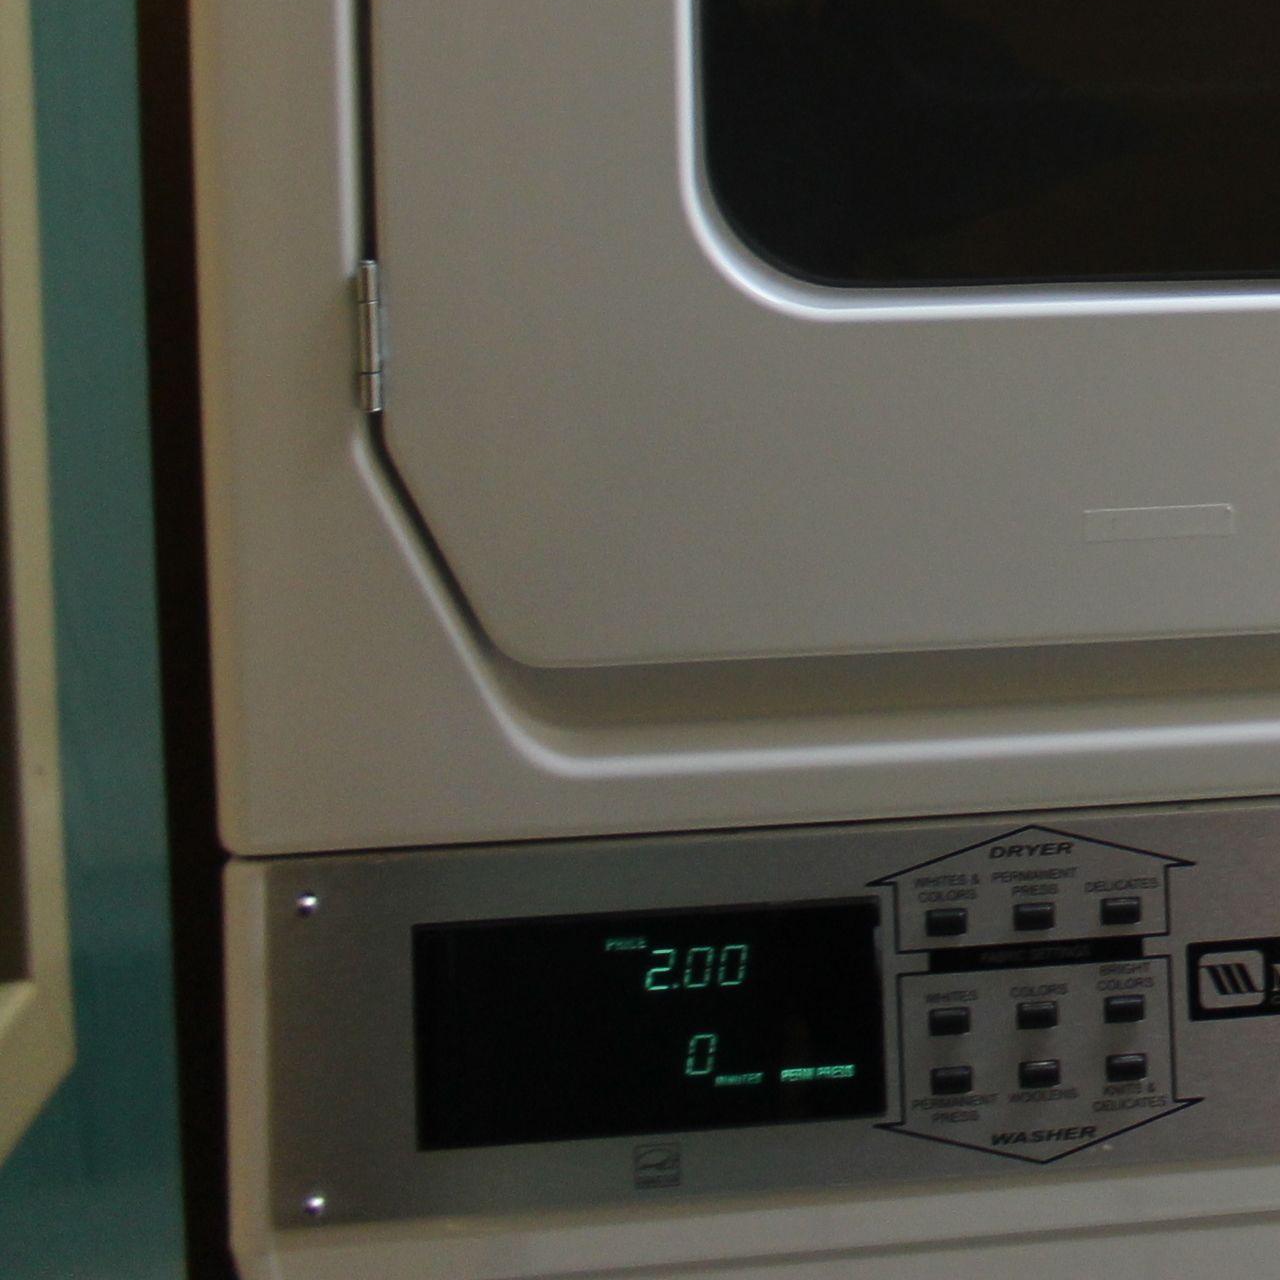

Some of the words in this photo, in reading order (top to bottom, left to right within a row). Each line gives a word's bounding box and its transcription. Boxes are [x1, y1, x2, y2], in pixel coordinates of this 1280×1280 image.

[988, 841, 1075, 859] DRYER
[991, 866, 1079, 884] PERMANENT
[1012, 883, 1059, 897] PRESS
[1084, 876, 1159, 893] DELICATES
[918, 888, 978, 903] COLORS
[645, 944, 748, 991] 2.00
[1009, 983, 1069, 998] COLORS
[1096, 977, 1154, 992] COLORS
[1092, 1096, 1168, 1112] DELICATES
[991, 1126, 1097, 1147] WASHER
